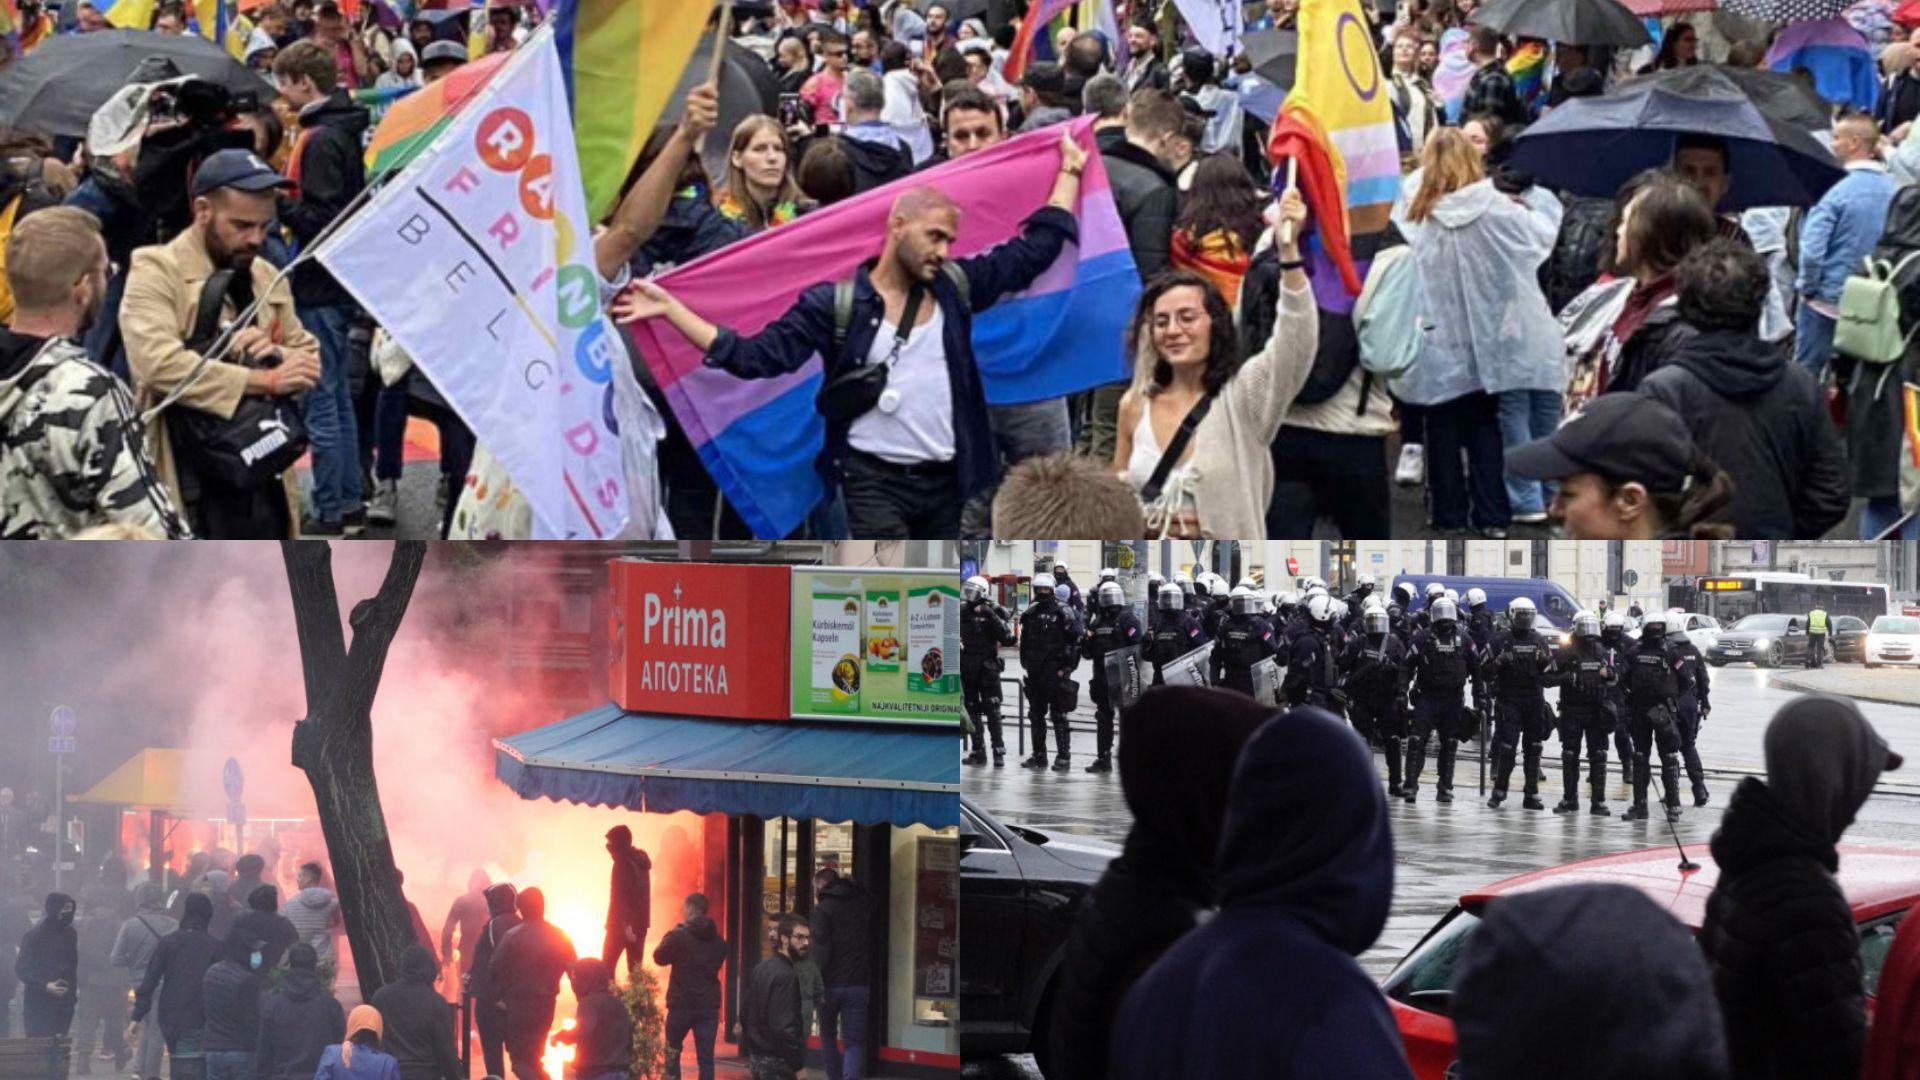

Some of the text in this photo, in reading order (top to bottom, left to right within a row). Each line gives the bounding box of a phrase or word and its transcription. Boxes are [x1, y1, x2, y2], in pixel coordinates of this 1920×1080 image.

[240, 428, 288, 467] PUMA
[644, 582, 726, 648] Prima
[641, 660, 729, 696] АПОТЕКА
